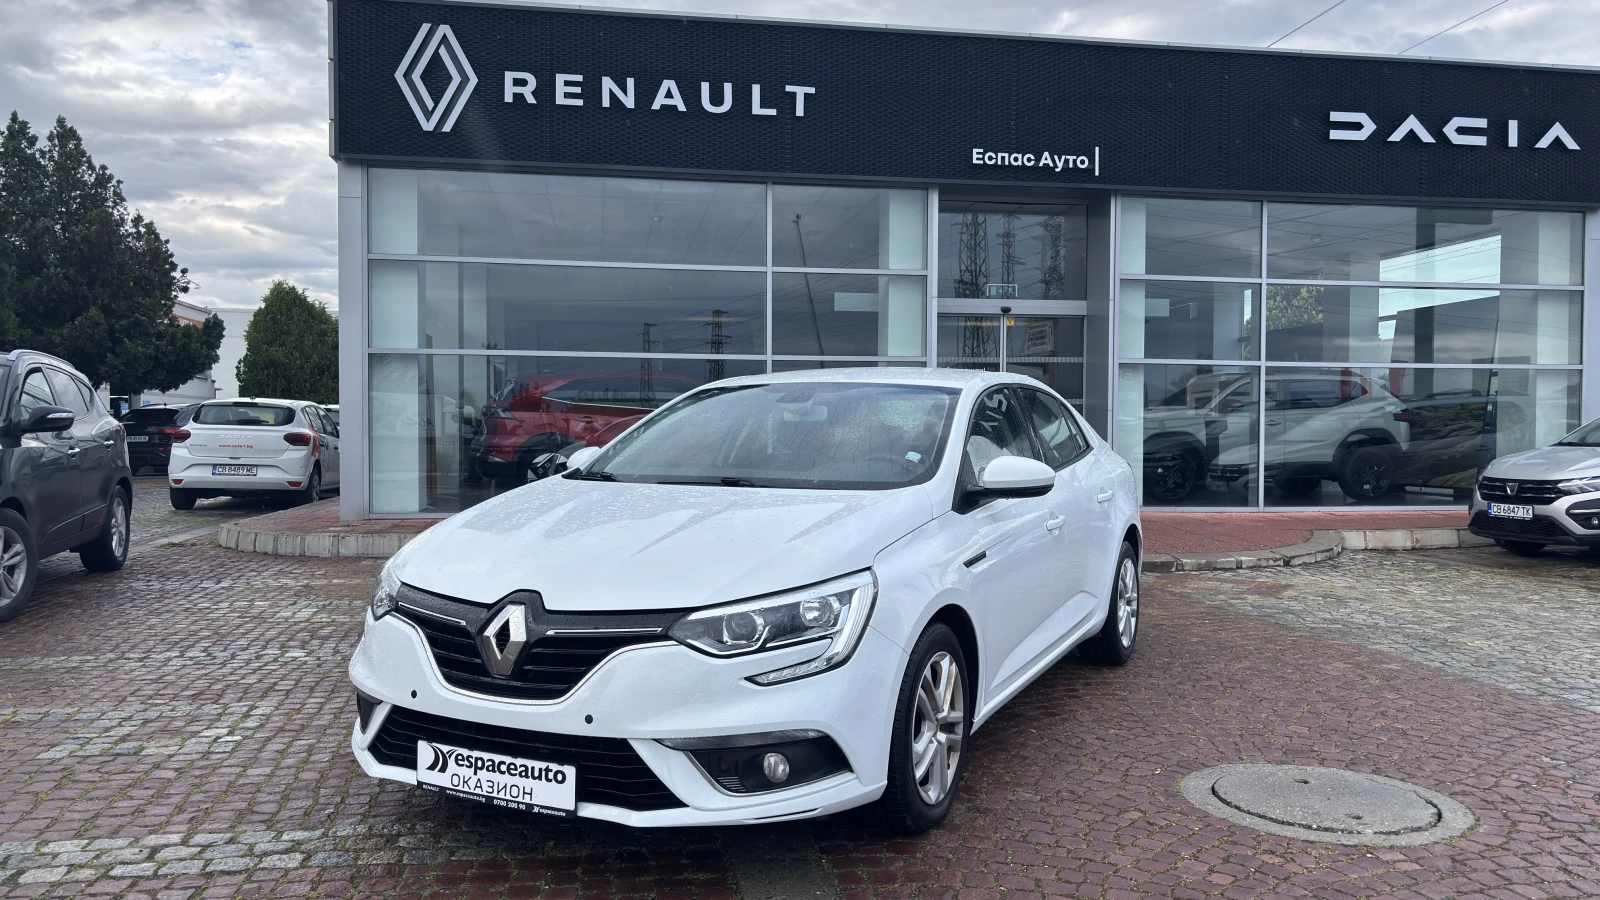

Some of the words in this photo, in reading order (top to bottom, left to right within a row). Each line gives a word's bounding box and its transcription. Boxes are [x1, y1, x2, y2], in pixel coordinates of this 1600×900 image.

[504, 71, 816, 117] RENAULT
[1329, 111, 1581, 150] DACIA
[972, 148, 1036, 167] Еспас
[1038, 151, 1089, 172] Ауто
[1492, 504, 1501, 514] CB
[1502, 505, 1520, 516] 6847
[1521, 506, 1532, 517] TK
[454, 752, 567, 785] espaceauto
[450, 773, 533, 802] ОКАЗИОН
[493, 798, 507, 808] 0700
[507, 801, 518, 809] 200
[519, 803, 526, 811] 90
